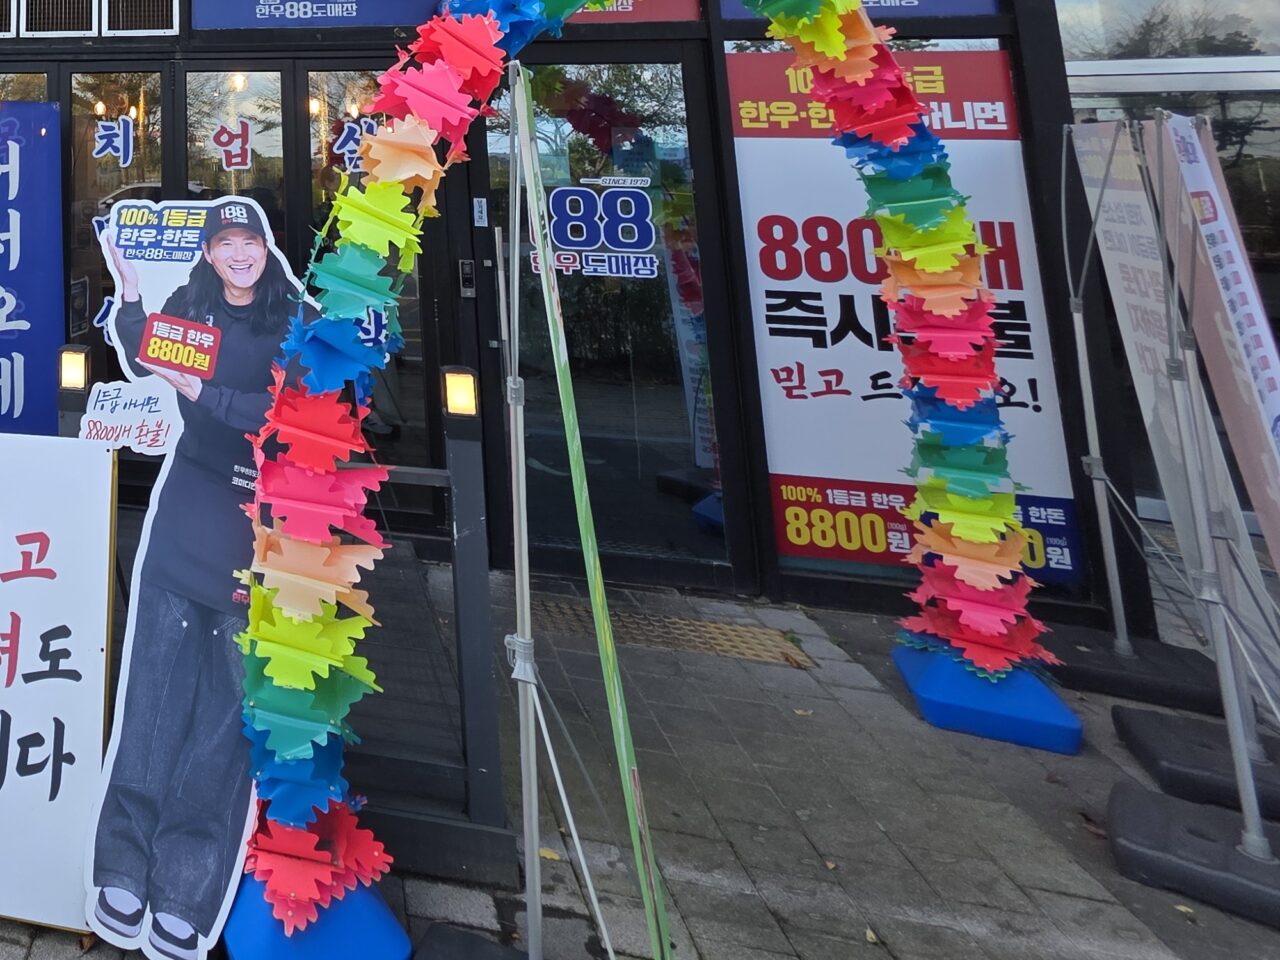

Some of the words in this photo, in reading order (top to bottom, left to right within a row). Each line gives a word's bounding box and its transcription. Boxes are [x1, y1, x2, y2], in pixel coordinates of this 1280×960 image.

[256, 1, 357, 19] 한우88도매장
[739, 101, 834, 128] 한우·한
[119, 207, 158, 226] 100%
[161, 208, 208, 228] 1등급
[550, 187, 655, 251] 88
[119, 229, 200, 248] 한우·한돈
[125, 248, 193, 261] 한우88도매장
[582, 253, 658, 278] 도매장
[152, 321, 184, 343] 1등급
[186, 329, 215, 349] 한우
[147, 337, 211, 372] 8800원
[770, 361, 852, 400] 믿고
[780, 484, 822, 503] 100%
[826, 489, 868, 507] 1등급
[871, 493, 906, 509] 한우
[1028, 506, 1066, 526] 한돈
[785, 506, 912, 554] 8800원
